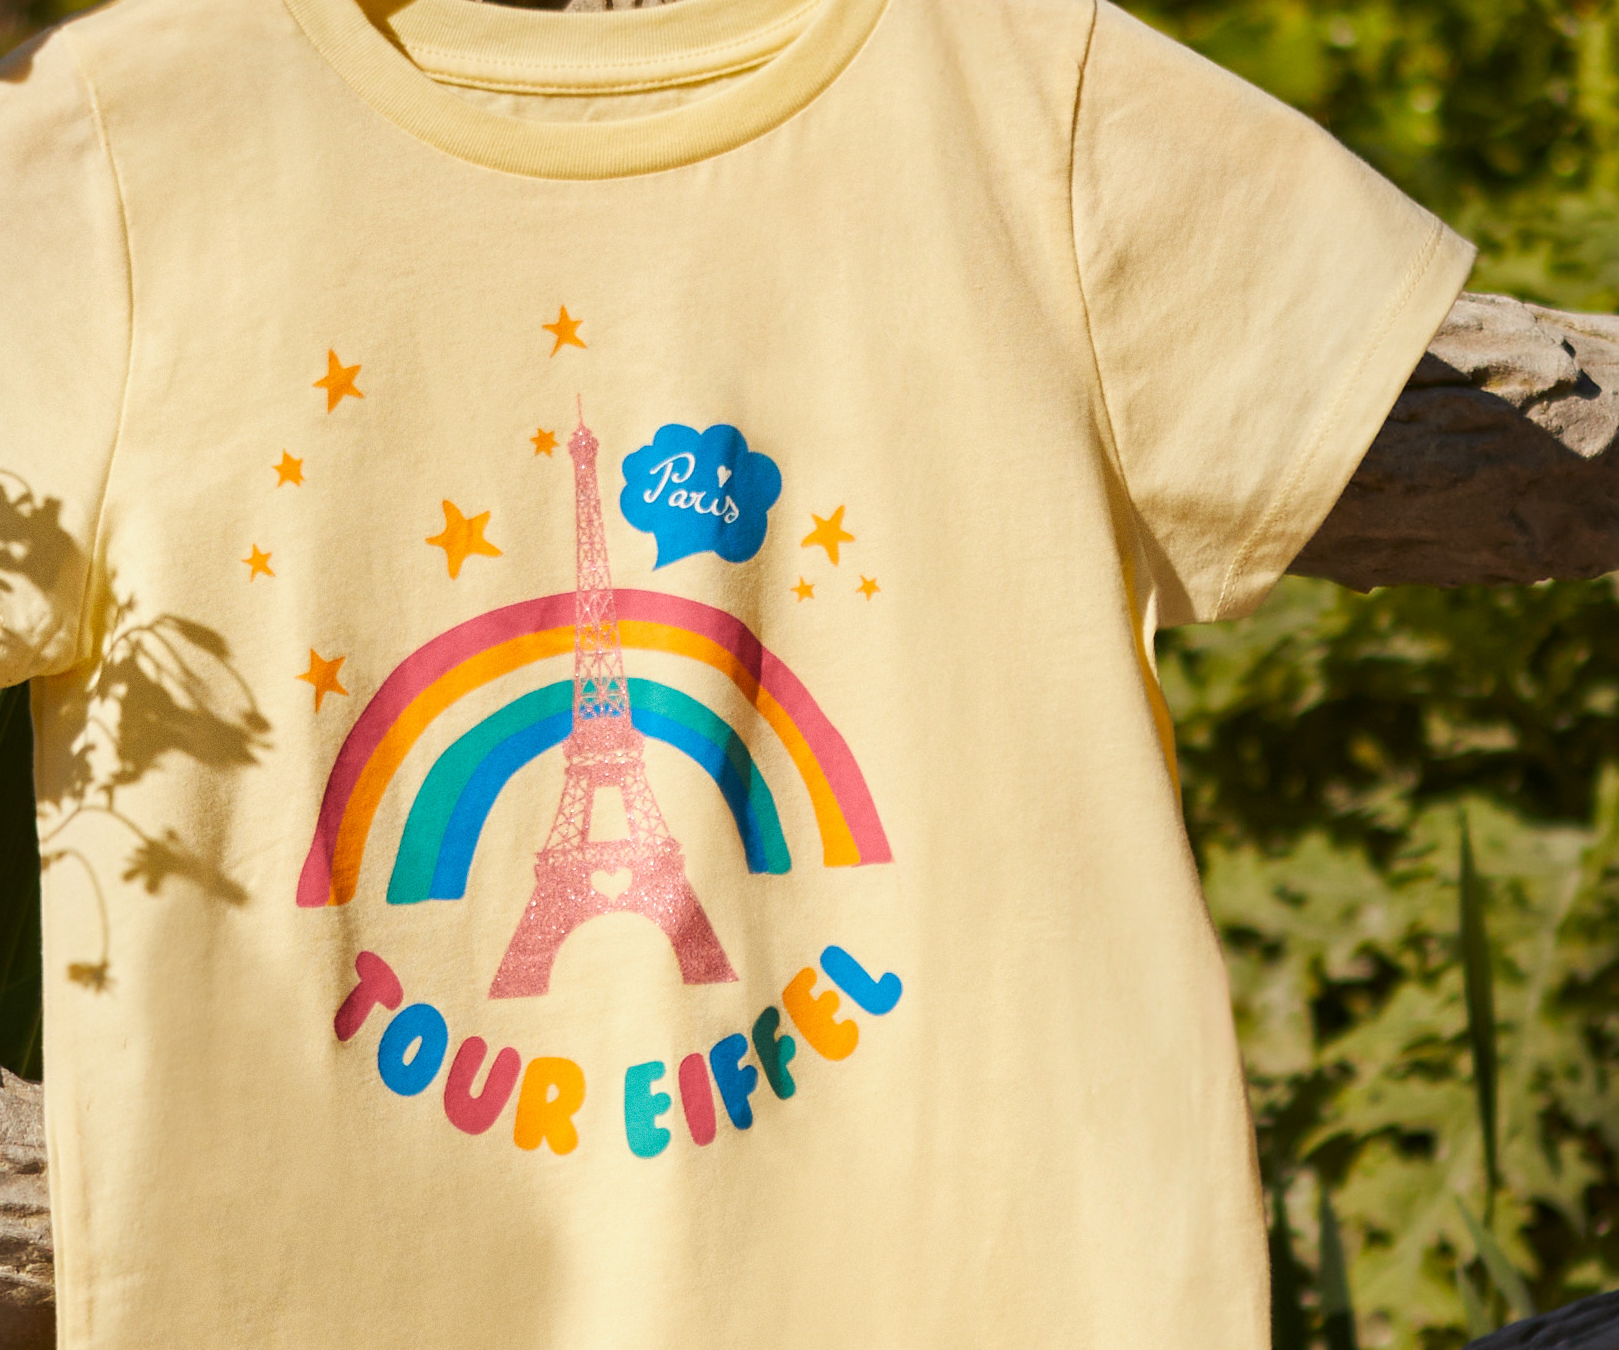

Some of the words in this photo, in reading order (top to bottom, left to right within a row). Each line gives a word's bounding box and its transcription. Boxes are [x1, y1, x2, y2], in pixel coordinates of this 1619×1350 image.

[643, 452, 739, 523] Paris
[334, 951, 586, 1156] TOUR
[624, 945, 903, 1159] EIFFEL
